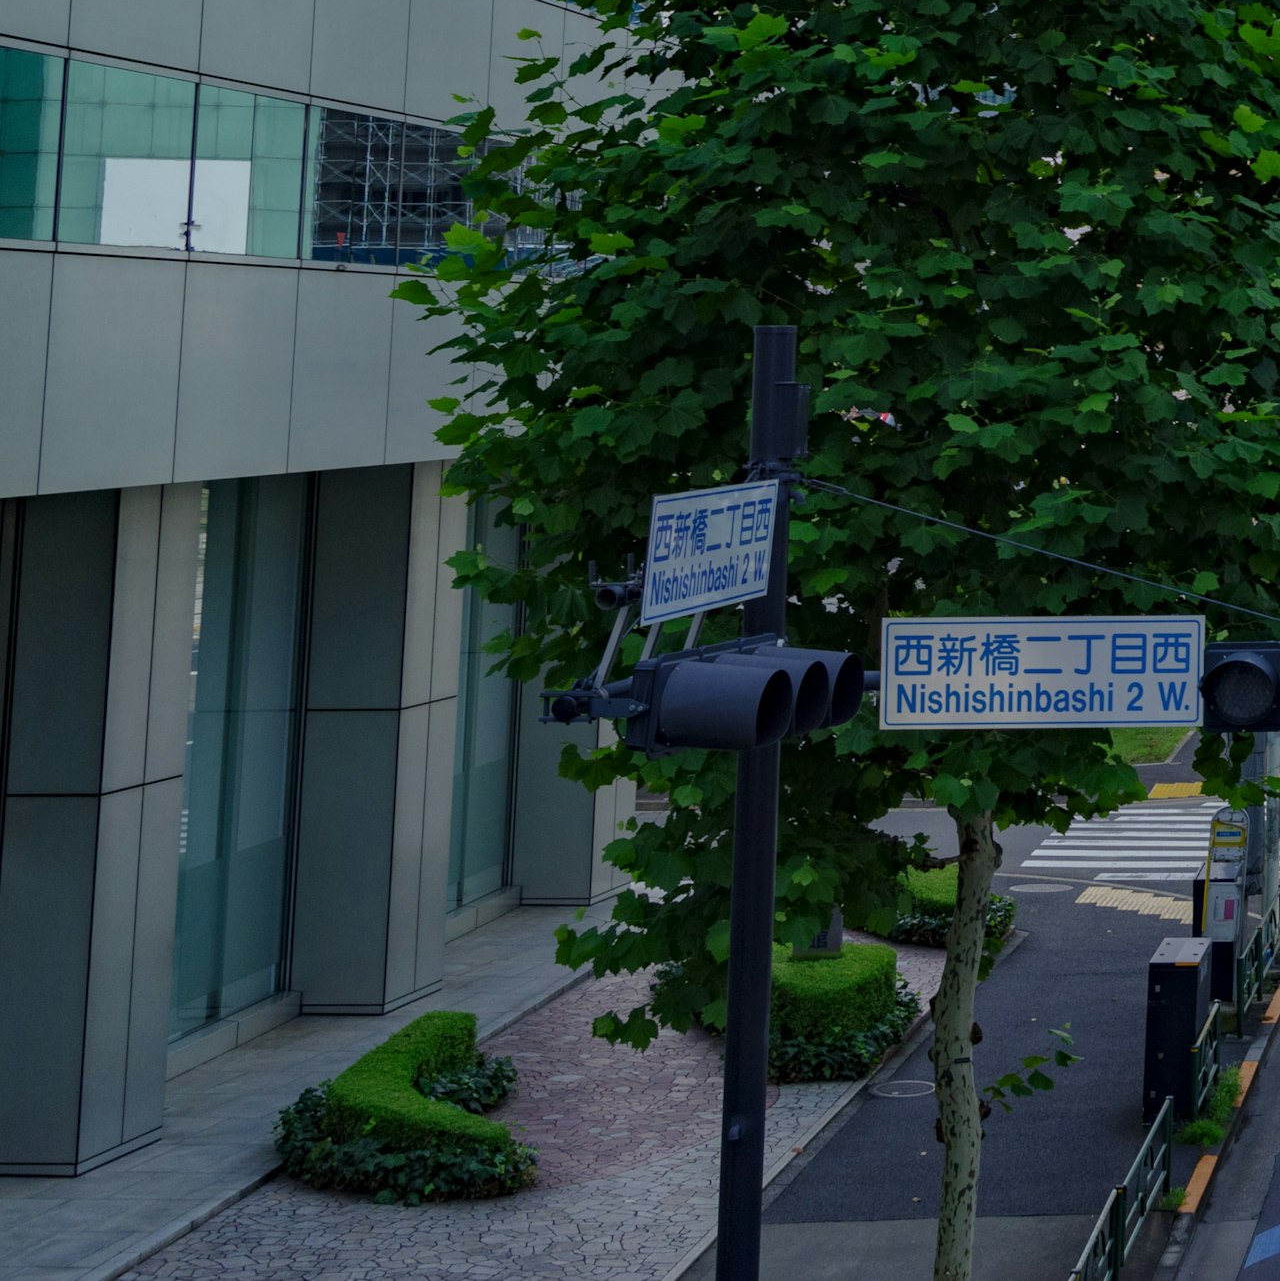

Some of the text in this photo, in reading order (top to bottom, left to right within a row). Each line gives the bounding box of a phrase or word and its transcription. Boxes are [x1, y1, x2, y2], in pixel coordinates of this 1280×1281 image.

[653, 497, 773, 563] 西新橋二丁目西
[650, 549, 766, 607] Nishishinbashi 2 W.
[894, 632, 1192, 677] 西新橋二丁目西
[897, 682, 1190, 715] Nishishinbashi 2 W.
